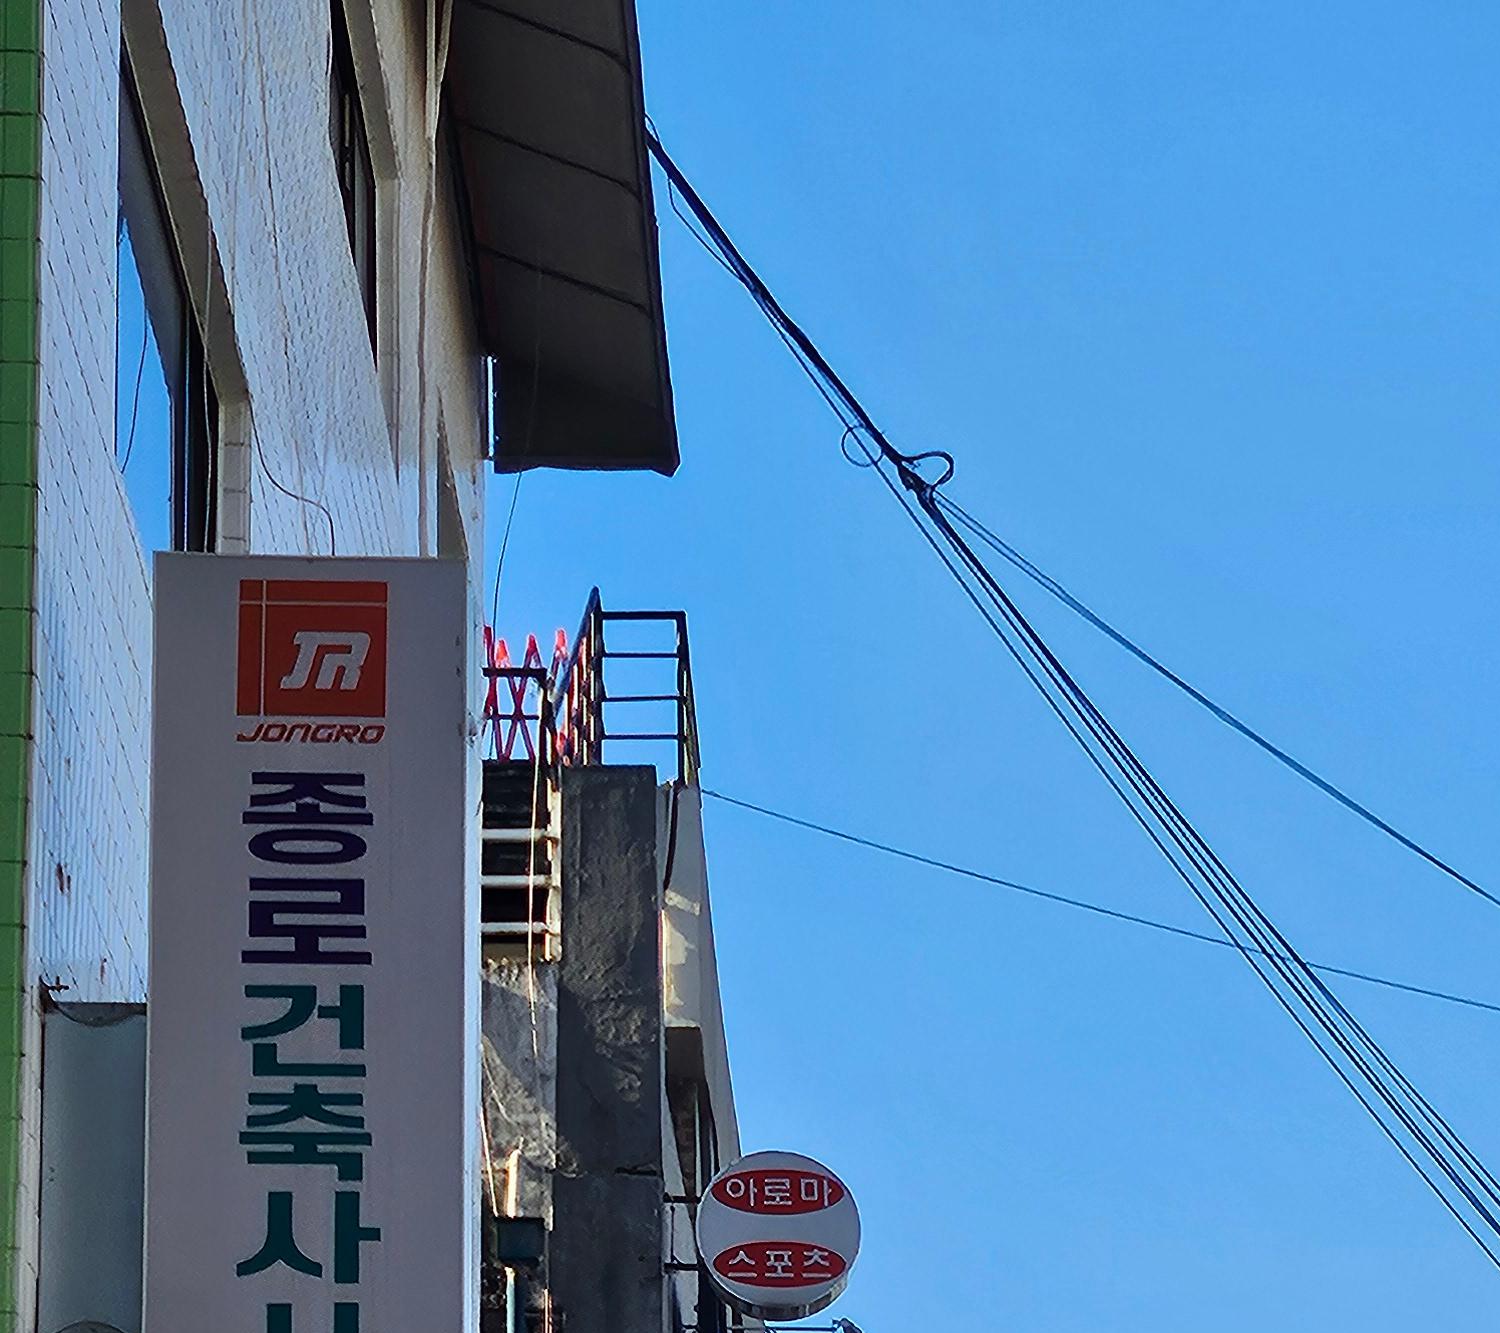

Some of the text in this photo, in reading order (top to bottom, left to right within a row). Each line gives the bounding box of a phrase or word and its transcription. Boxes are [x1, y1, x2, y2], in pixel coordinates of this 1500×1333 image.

[236, 722, 386, 745] JONGRO
[726, 1178, 833, 1207] 아로마
[727, 1249, 832, 1278] 스포츠
